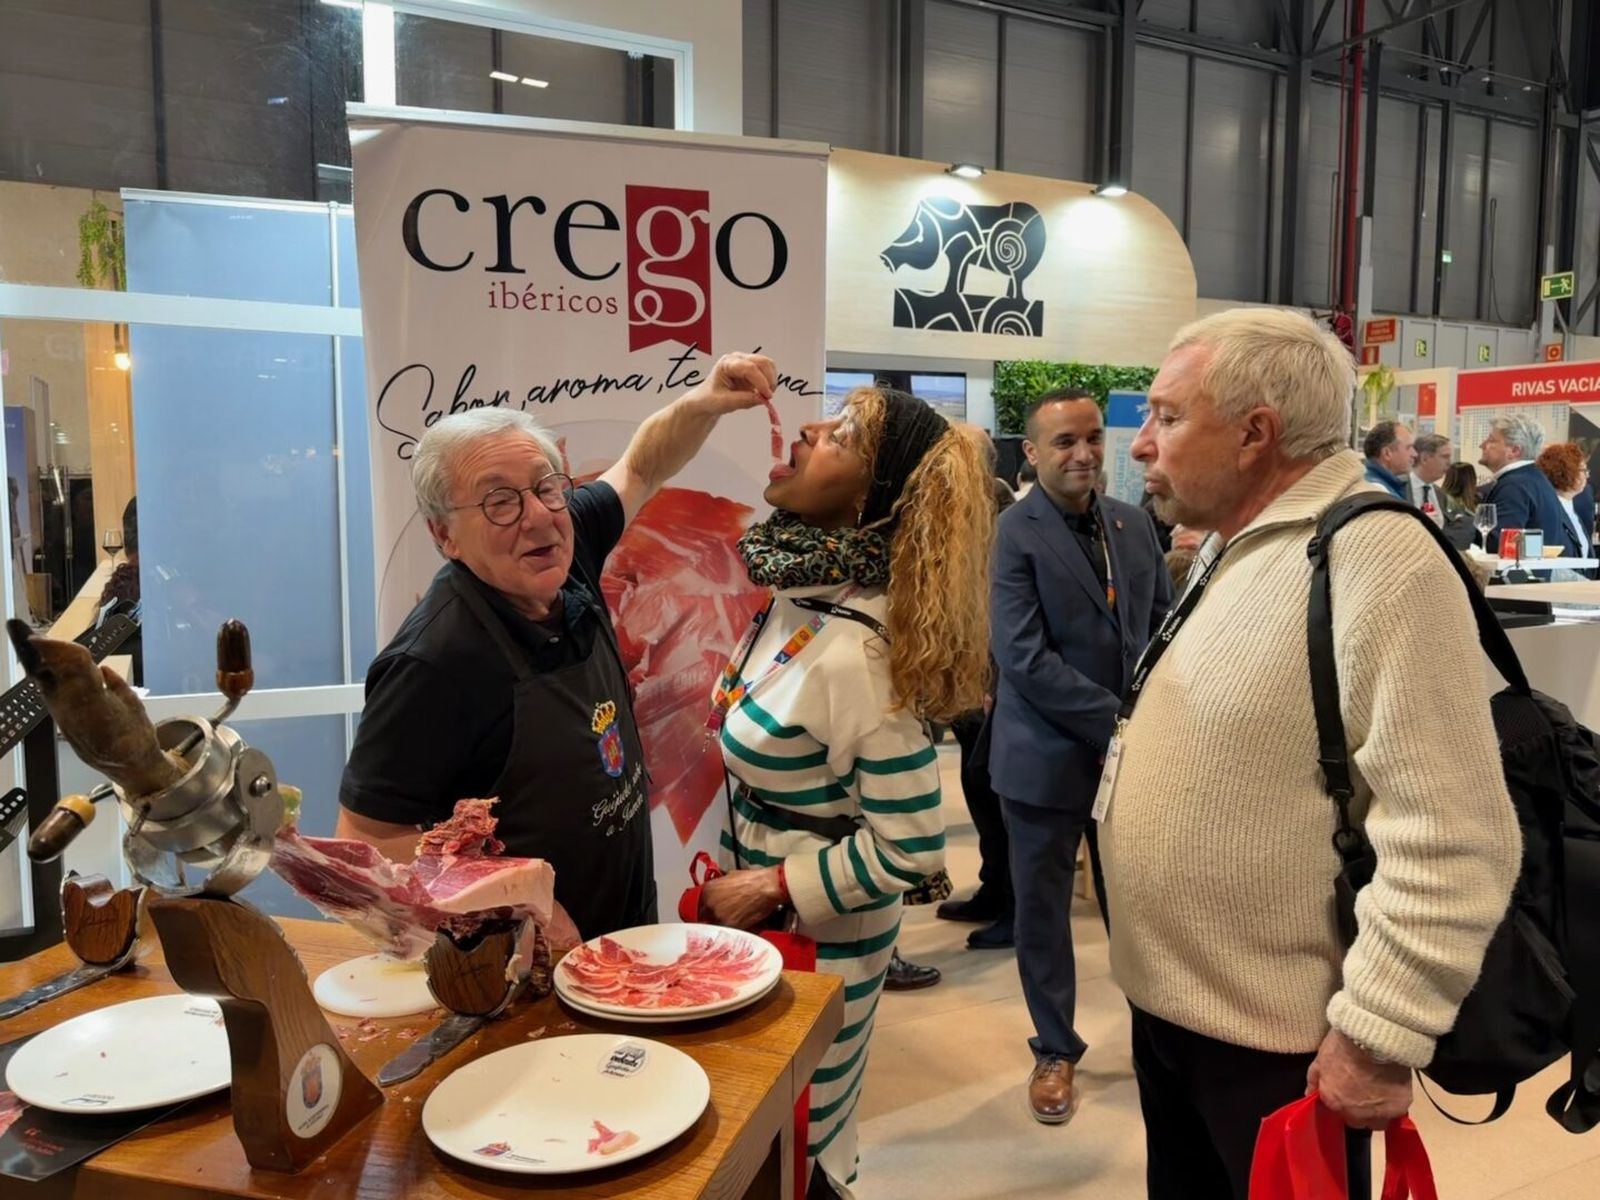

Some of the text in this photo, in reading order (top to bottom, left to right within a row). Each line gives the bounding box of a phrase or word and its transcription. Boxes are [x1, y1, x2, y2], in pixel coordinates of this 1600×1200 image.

[402, 188, 789, 328] crego
[487, 281, 619, 315] ibéricos
[1512, 380, 1556, 396] RIVAS
